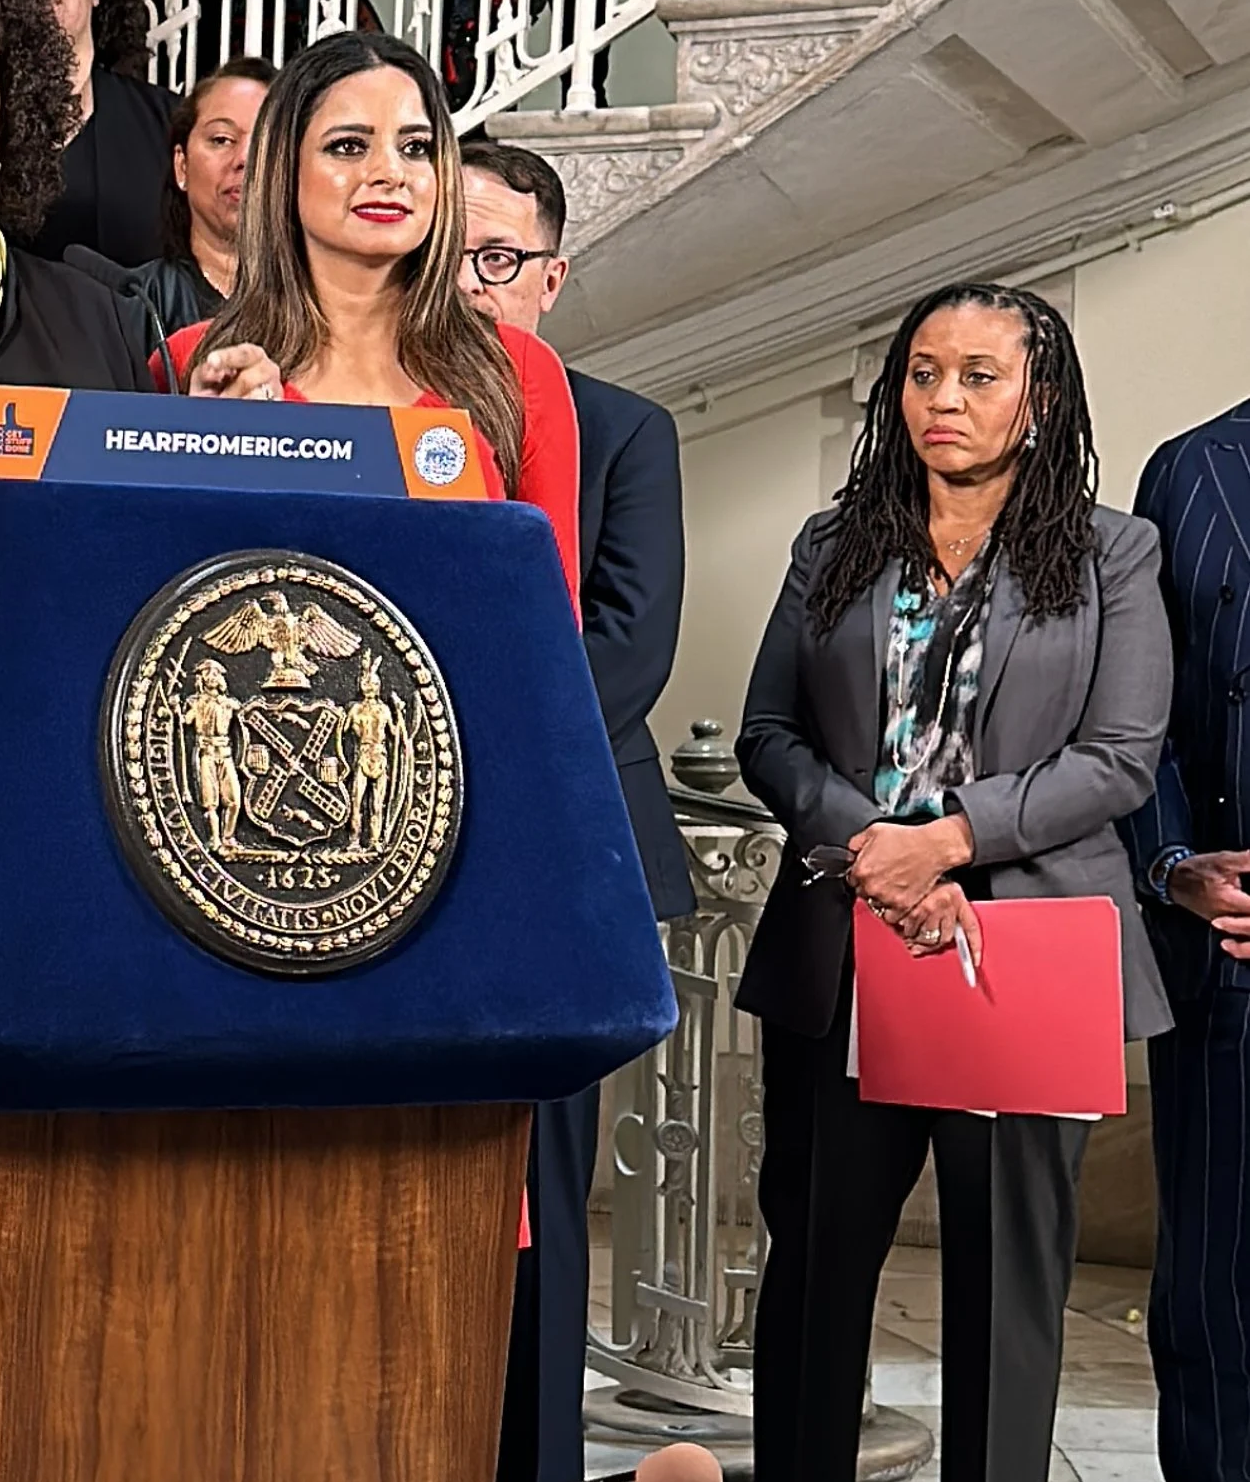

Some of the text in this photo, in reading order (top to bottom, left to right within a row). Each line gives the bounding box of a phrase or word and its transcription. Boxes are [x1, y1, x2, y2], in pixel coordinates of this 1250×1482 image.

[105, 429, 353, 460] HEARFROMERIC.COM
[266, 867, 332, 889] 1625
[331, 875, 394, 924] NOVI
